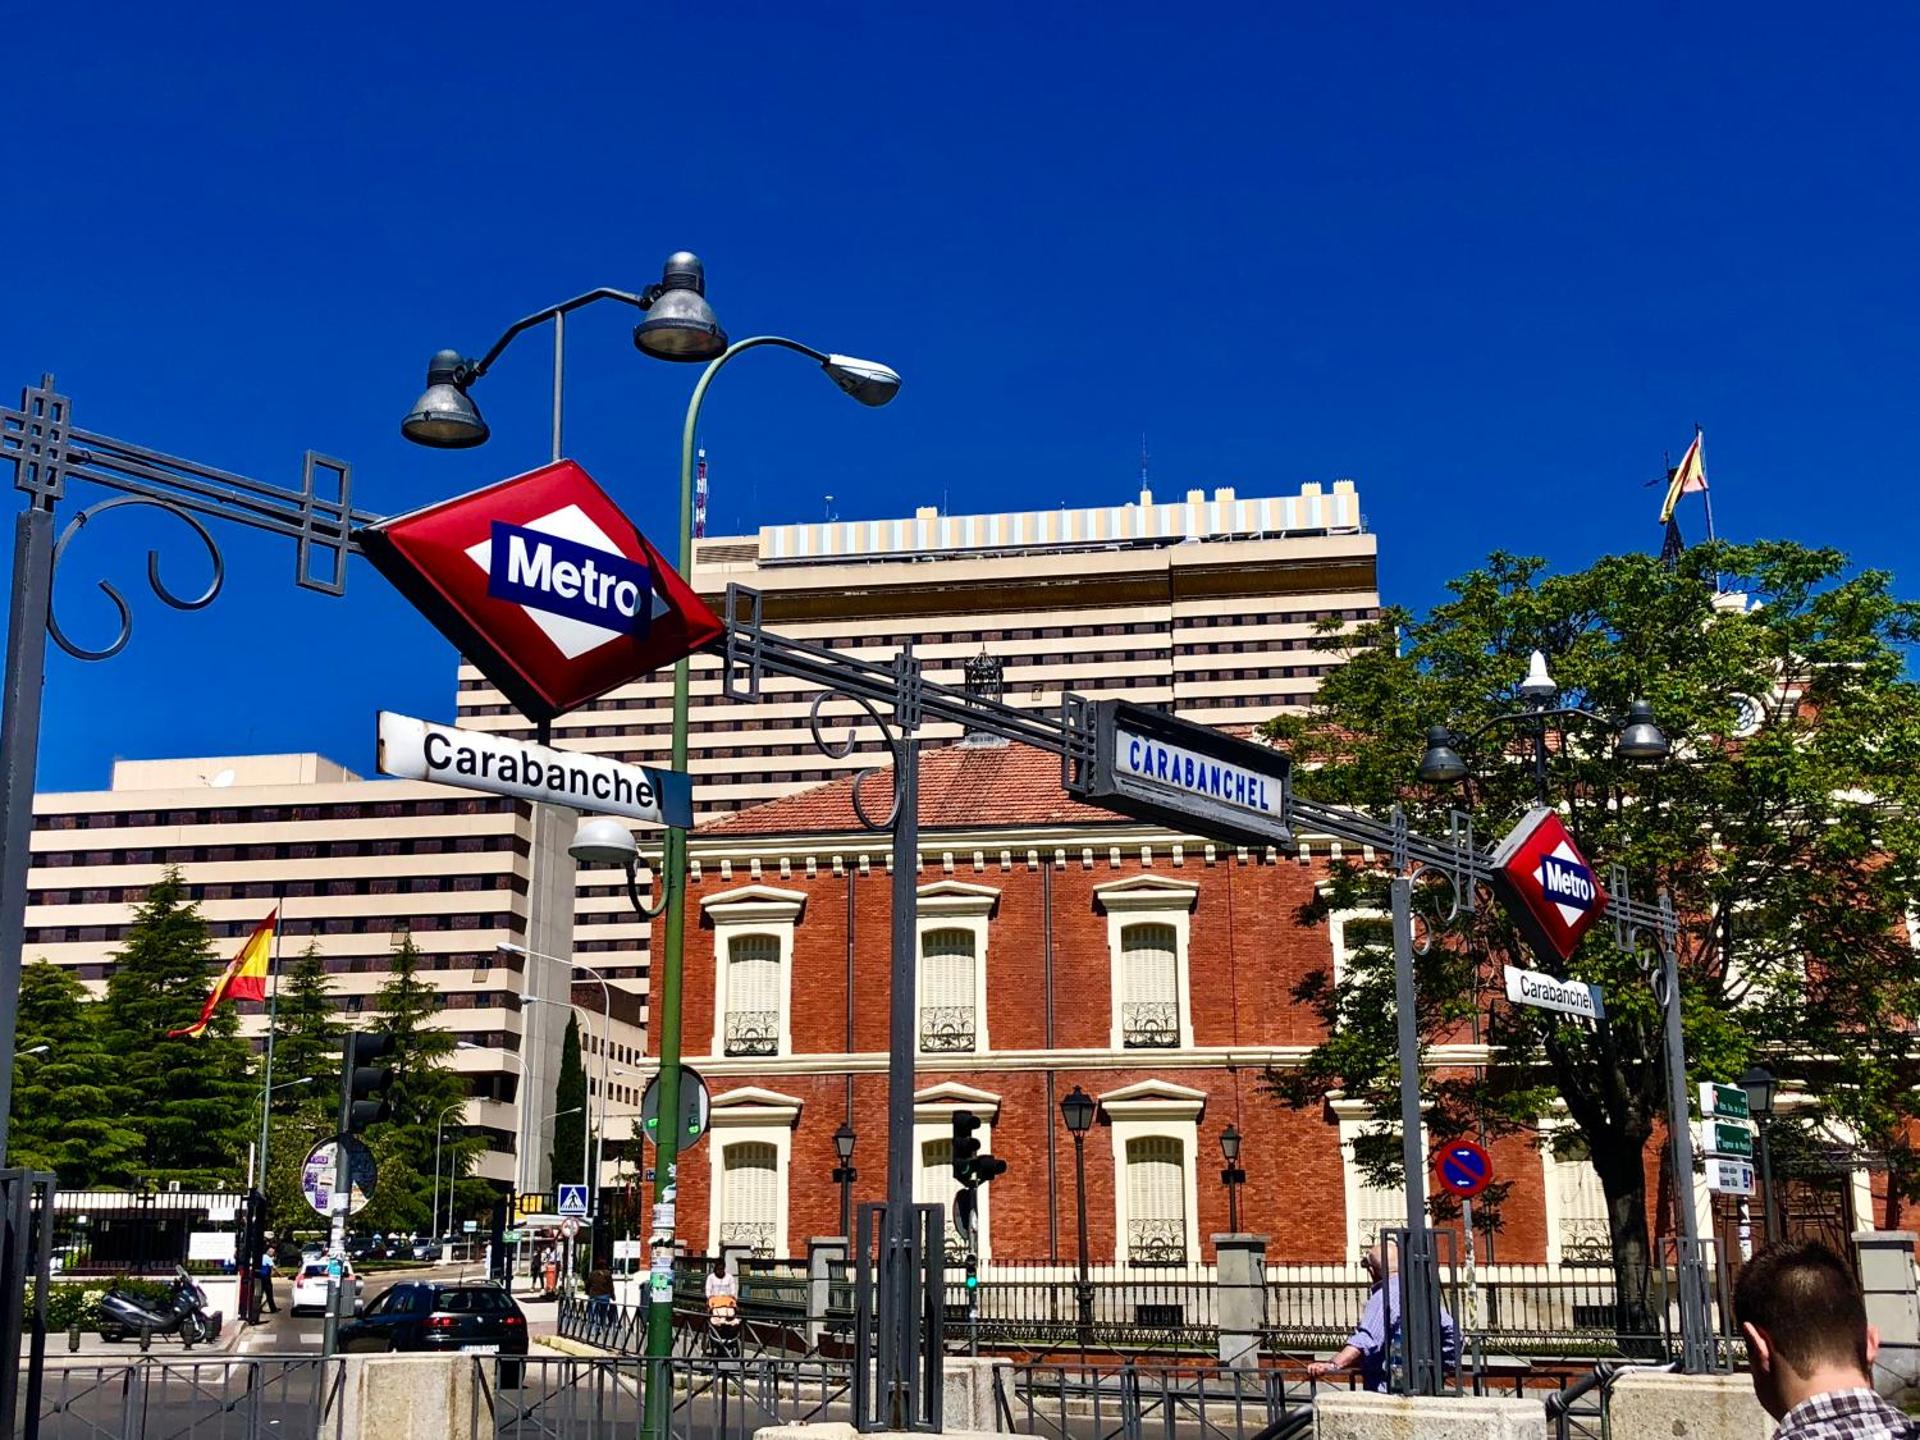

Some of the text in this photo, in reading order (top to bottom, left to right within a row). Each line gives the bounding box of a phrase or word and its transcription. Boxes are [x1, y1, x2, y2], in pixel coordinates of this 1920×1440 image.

[507, 534, 642, 619] Metro
[423, 731, 664, 811] Carabanchel
[1128, 740, 1269, 811] CARABANCHEL
[1545, 861, 1590, 901] Metro
